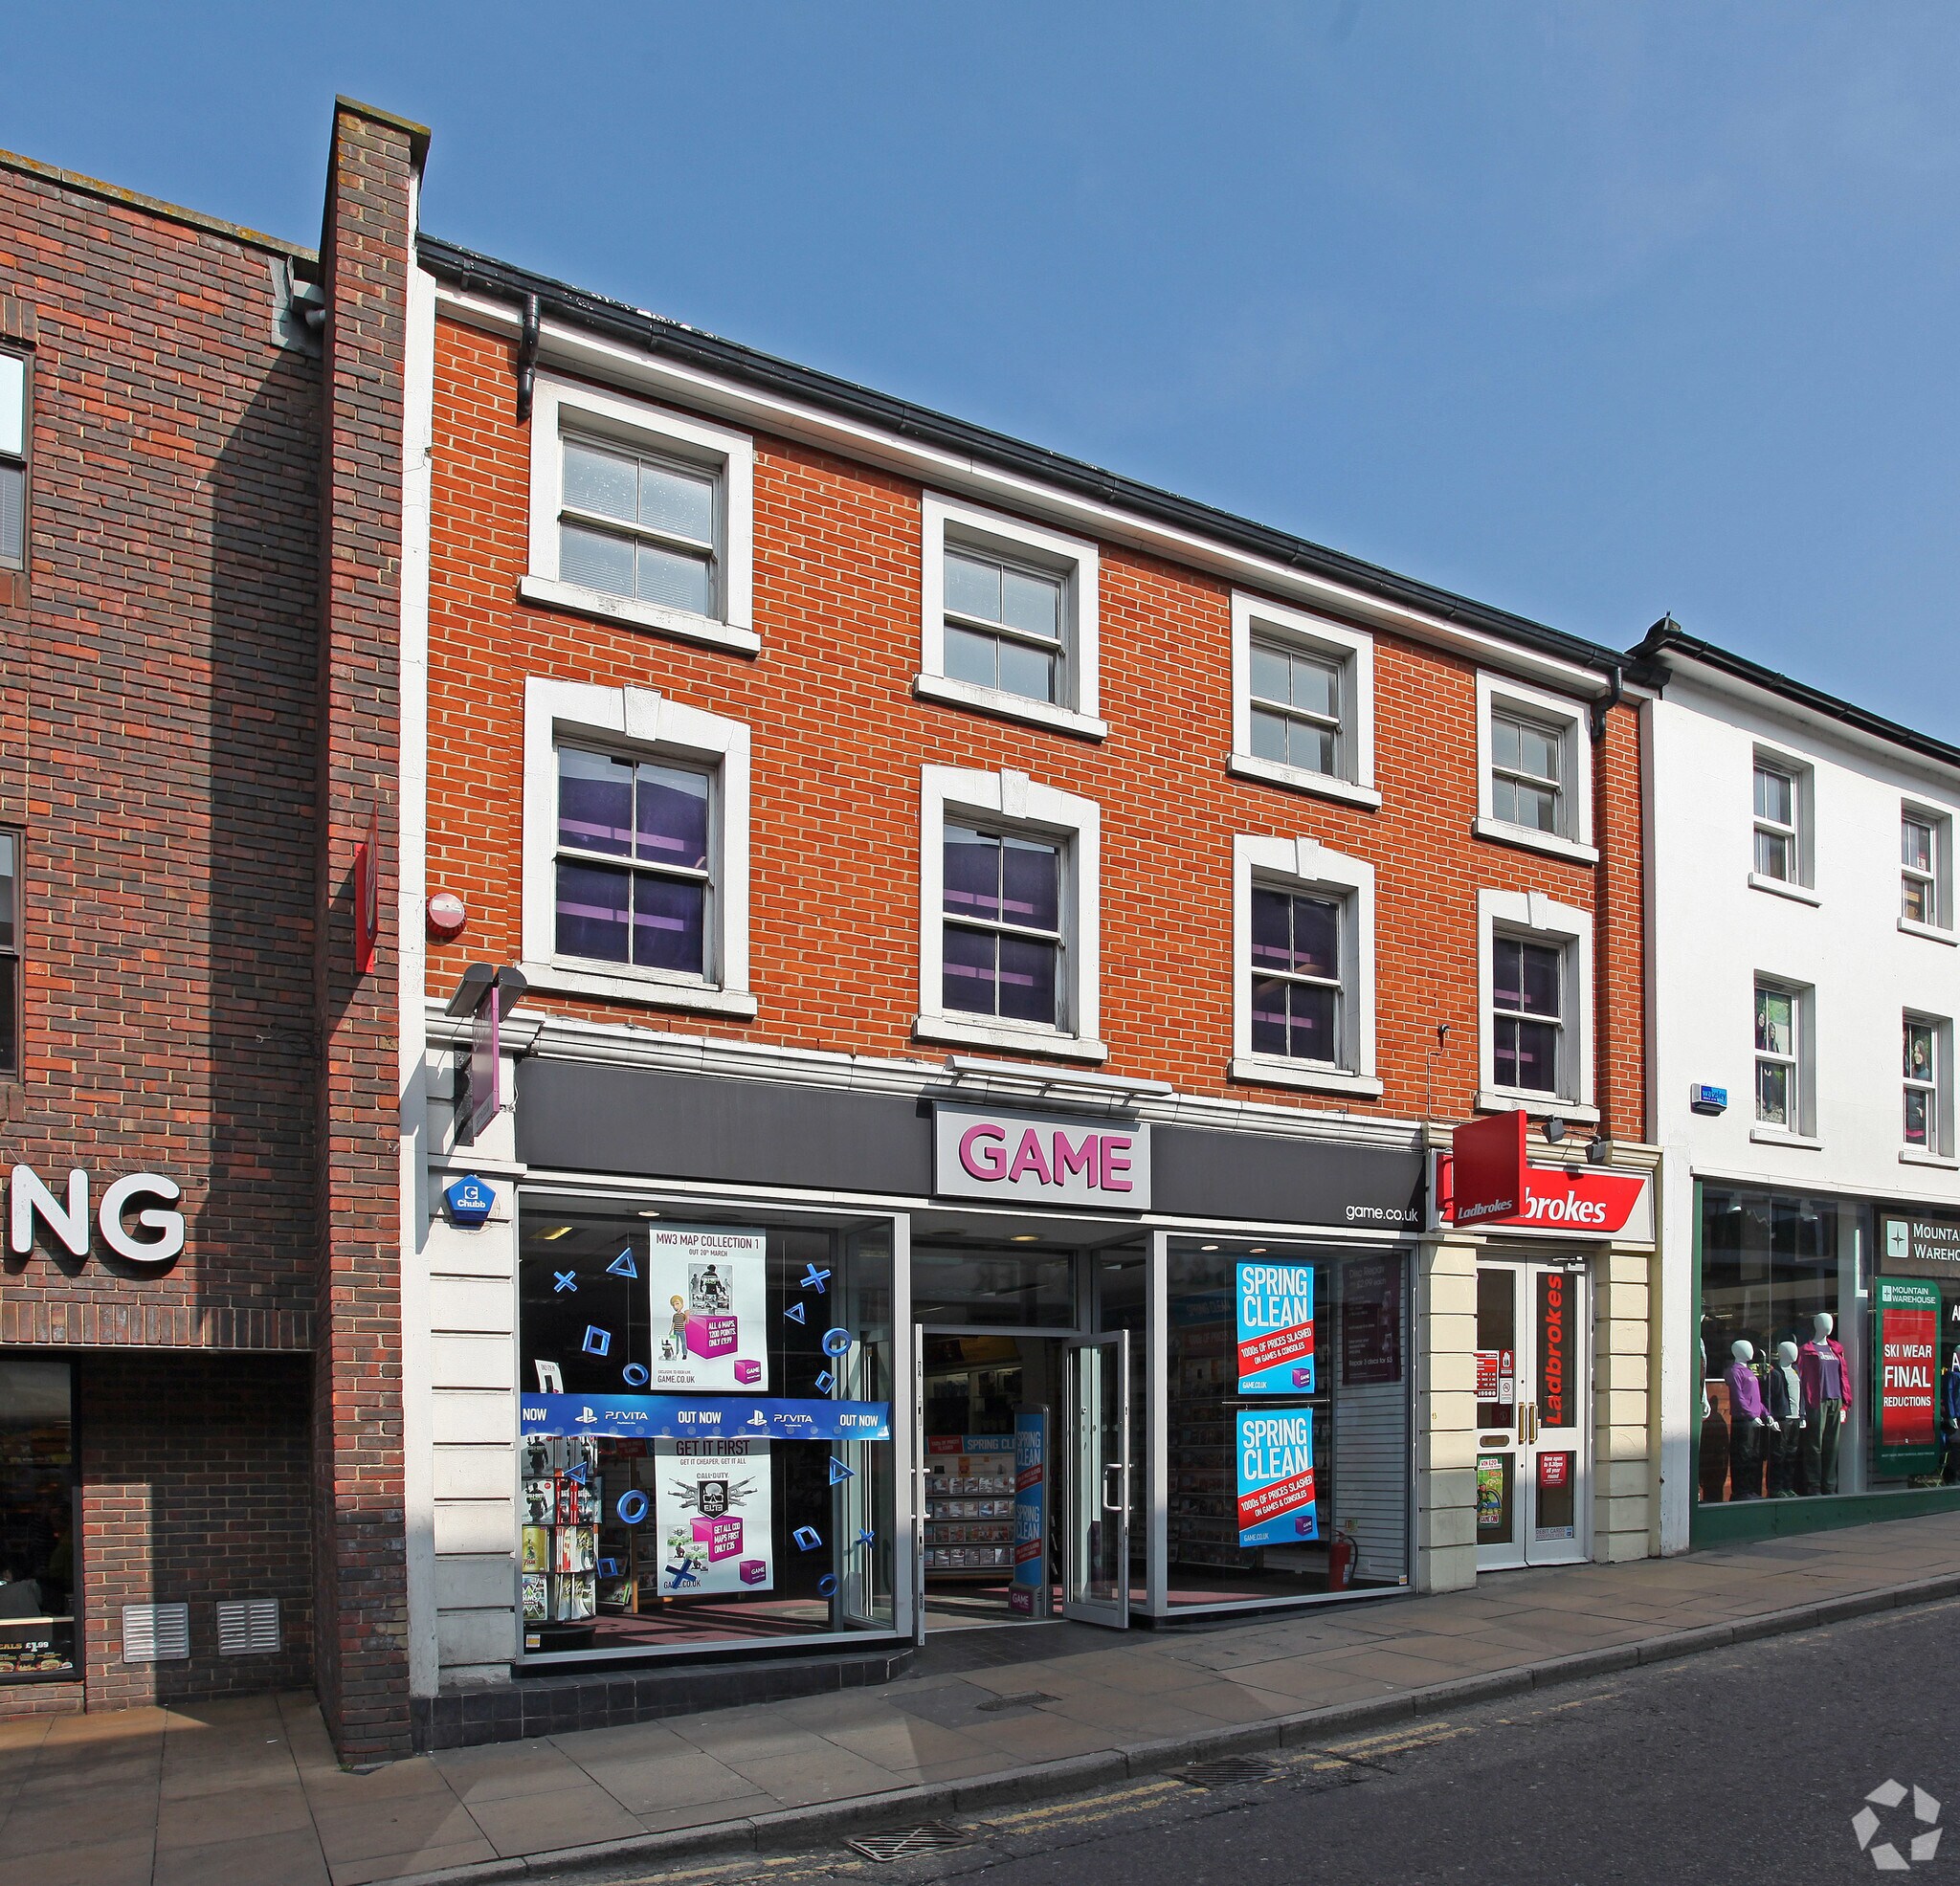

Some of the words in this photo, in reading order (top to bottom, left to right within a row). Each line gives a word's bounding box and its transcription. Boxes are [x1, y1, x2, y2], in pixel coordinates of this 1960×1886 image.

[959, 1123, 1133, 1192] GAME
[457, 1198, 486, 1209] Chubb
[1458, 1199, 1513, 1220] Ladbrokes
[1520, 1187, 1607, 1224] brokes
[10, 1163, 186, 1263] NG
[1346, 1205, 1418, 1222] game.co.uk
[656, 1233, 678, 1245] MW3
[679, 1234, 700, 1247] MAP
[701, 1235, 752, 1249] COLLECTION
[754, 1238, 759, 1249] 1
[1913, 1223, 1960, 1242] MOUNTA
[1242, 1267, 1307, 1296] SPRING
[1892, 1286, 1929, 1295] MOUNTAIN
[1892, 1296, 1936, 1304] WAREHOUSE
[1244, 1296, 1307, 1327] CLEAN
[1240, 1345, 1259, 1358] 1000s
[1258, 1342, 1266, 1351] OF
[1267, 1336, 1286, 1348] PRICES
[1286, 1327, 1312, 1343] SLASHED
[1546, 1275, 1563, 1425] Ladbrokes
[1884, 1344, 1900, 1357] SKI
[1902, 1344, 1932, 1358] WEAR
[1261, 1351, 1278, 1362] GAMES
[1282, 1342, 1305, 1355] CONSOLES
[657, 1375, 696, 1384] GAME.CO.UK
[1884, 1365, 1931, 1387] FINAL
[1883, 1396, 1931, 1408] REDUCTIONS
[523, 1408, 547, 1421] NOW
[678, 1411, 697, 1424] OUT
[699, 1411, 722, 1425] NOW
[839, 1414, 857, 1427] OUT
[858, 1416, 879, 1427] NOW
[1016, 1431, 1041, 1448] SPRING
[1243, 1418, 1307, 1449] SPRING
[676, 1440, 699, 1456] GET
[702, 1440, 713, 1455] IT
[717, 1440, 750, 1455] FIRST
[968, 1439, 998, 1451] SPRING
[1016, 1449, 1041, 1466] CLEAN
[1245, 1447, 1308, 1480] CLEAN
[1240, 1499, 1259, 1512] 1000s
[1258, 1495, 1267, 1504] OF
[1268, 1486, 1288, 1500] PRICES
[1289, 1475, 1313, 1492] SLASHED
[1254, 1508, 1262, 1518] ON
[1262, 1502, 1279, 1514] GAMES
[1284, 1490, 1307, 1505] CONSOLES
[1016, 1505, 1040, 1522] SPRING
[713, 1525, 723, 1534] GET
[714, 1535, 727, 1543] MAPS
[727, 1531, 740, 1540] FIRST
[1016, 1521, 1040, 1540] CLEAN
[1243, 1533, 1269, 1542] GAME.CO.UK
[726, 1542, 735, 1551] £35
[751, 1566, 765, 1575] GAME
[663, 1580, 702, 1588] GA.CO.UK
[1013, 1592, 1029, 1606] GAME
